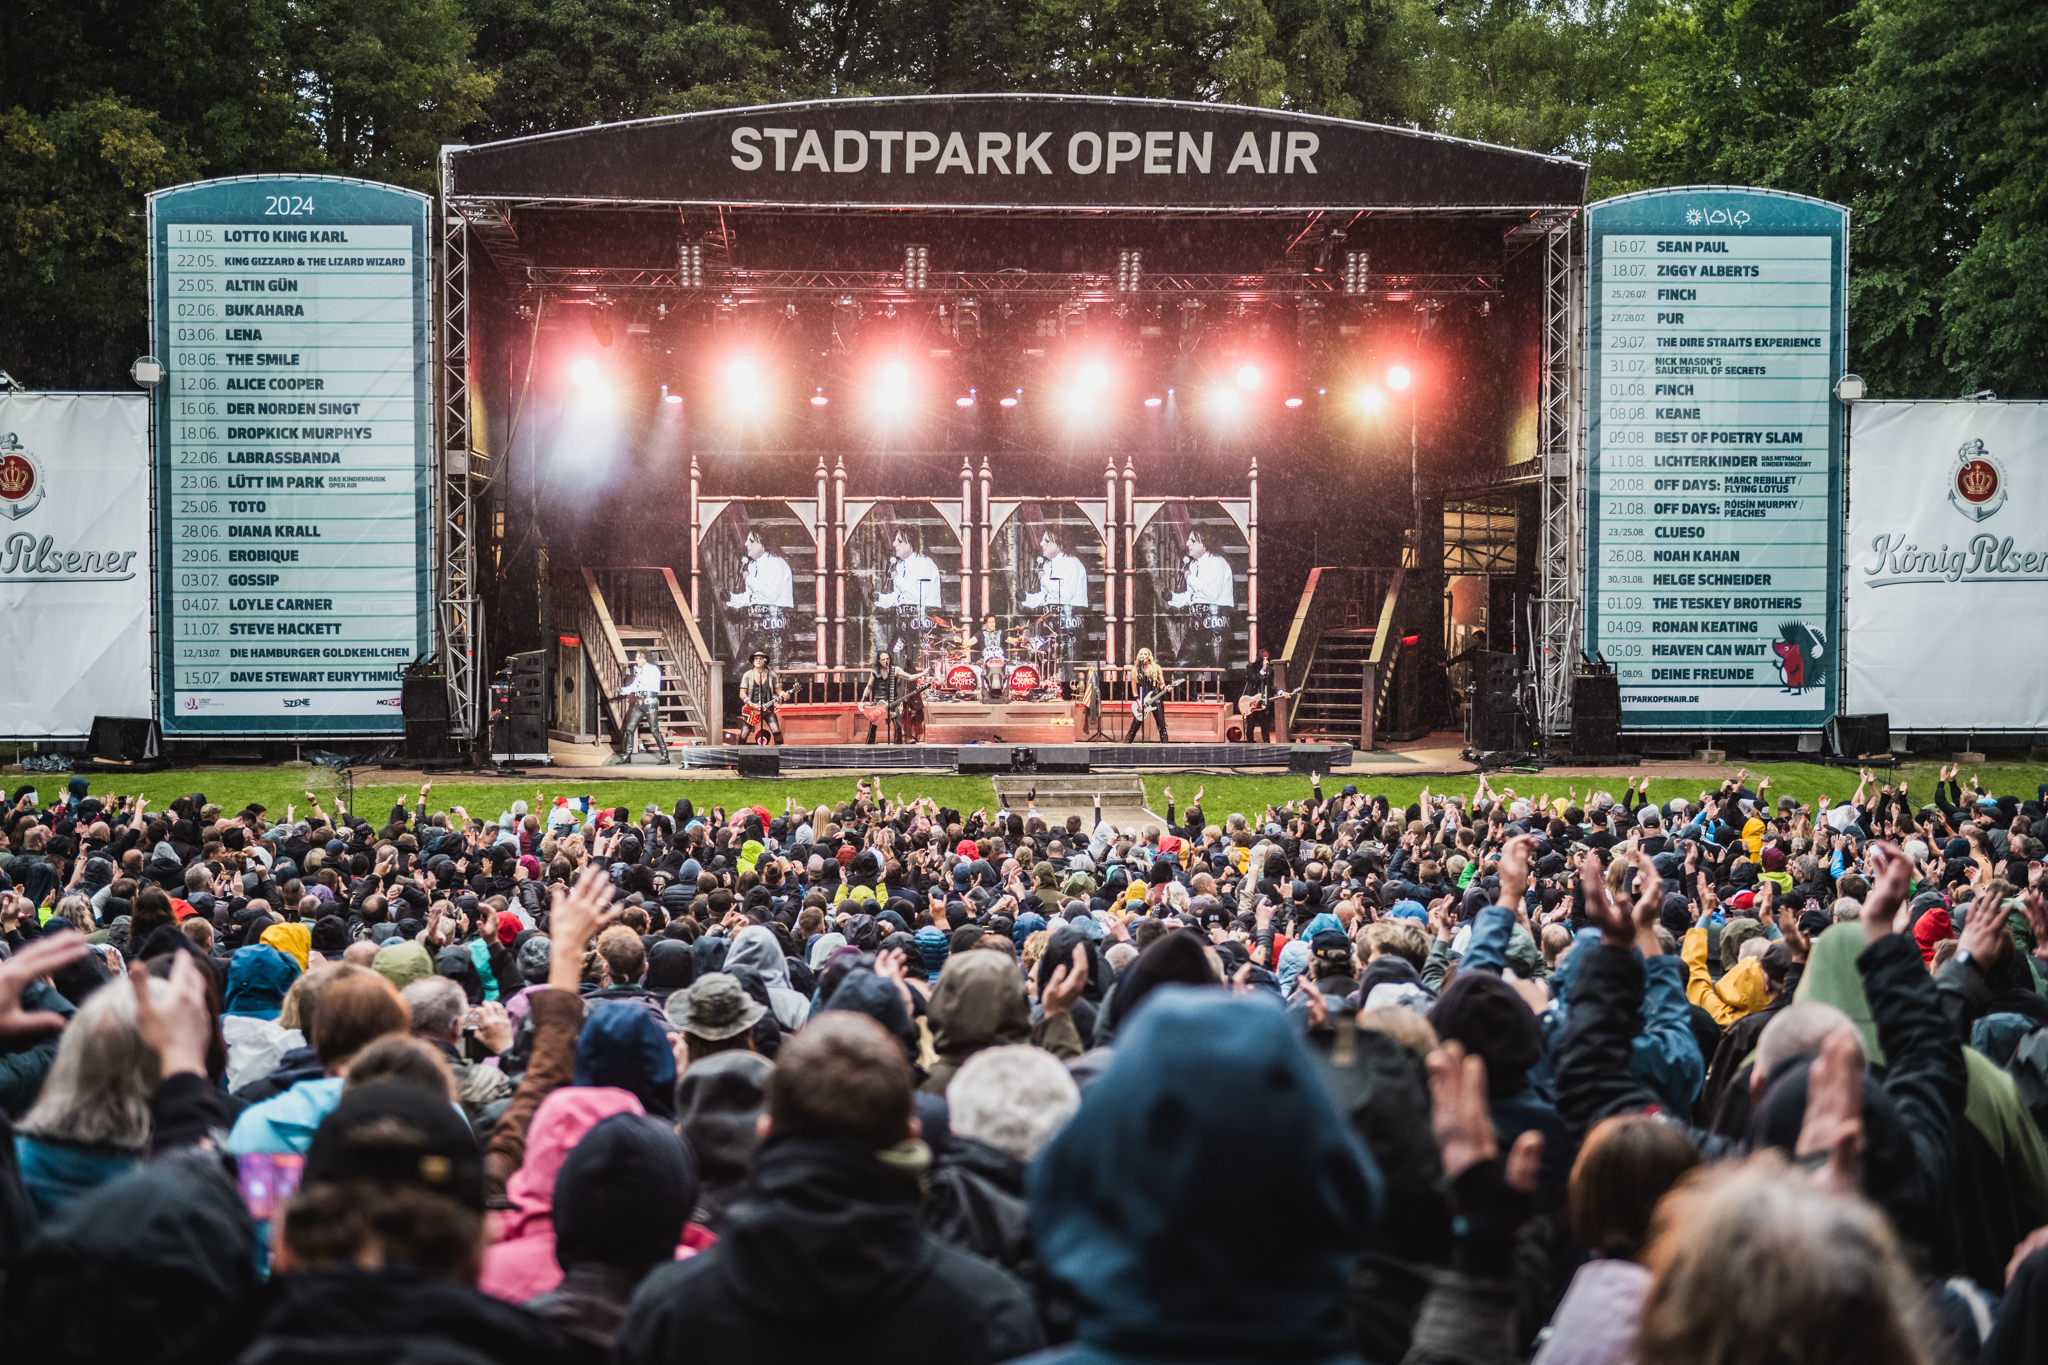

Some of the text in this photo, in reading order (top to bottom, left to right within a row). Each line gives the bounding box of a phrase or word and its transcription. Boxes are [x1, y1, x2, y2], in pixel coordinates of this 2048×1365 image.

[730, 127, 1320, 175] STADTPARK OPEN AIR
[265, 196, 314, 215] 2024
[178, 230, 215, 242] 11.05.
[225, 230, 348, 242] LOTTO KING KARL
[1613, 241, 1646, 252] 16.07.
[1657, 241, 1729, 253] SEAN PAUL
[177, 255, 217, 267] 22.05.
[225, 257, 405, 266] KING GIZZARD & THE LIZARD WIZARD
[1613, 265, 1646, 276] 18.07.
[1657, 265, 1759, 277] ZIGGY ALBERTS
[178, 279, 216, 291] 25.05.
[225, 278, 297, 292] ALTIN GÜN
[1658, 289, 1696, 300] FINCH
[178, 304, 217, 316] 02.06.
[225, 304, 304, 316] BUKAHARA
[1658, 313, 1684, 324] PUR
[179, 328, 217, 340] 03.06.
[226, 329, 262, 341] LENA
[1611, 336, 1645, 348] 29.07.
[1657, 338, 1821, 347] THE DIRE STRAITS EXPERIENCE
[179, 353, 218, 365] 08.06.
[226, 354, 299, 366] THE SMILE
[1655, 357, 1721, 366] NICK MASON'S
[1611, 360, 1645, 372] 31.07.
[1655, 366, 1766, 375] SAUCERFUL OF SECRETS
[180, 378, 219, 390] 12.06.
[227, 378, 324, 390] ALICE COOPER
[1610, 384, 1647, 396] 01.08.
[1655, 384, 1693, 396] FINCH
[181, 402, 218, 414] 16.06.
[227, 403, 360, 415] DER NORDEN SINGT
[1610, 408, 1647, 420] 08.08.
[1656, 408, 1700, 419] KEANE
[181, 427, 219, 439] 18.06.
[228, 427, 372, 439] DROPKICK MURPHYS
[1610, 431, 1646, 443] 09.08.
[1655, 432, 1802, 443] BEST OF POETRY SLAM
[180, 452, 220, 463] 22.06.
[228, 452, 340, 464] LABRASSBANDA
[1611, 455, 1646, 467] 11.08.
[1655, 456, 1758, 467] LICHTERKINDER
[26, 448, 46, 484] LAUDATUR
[1990, 454, 2008, 487] LAUDATUR
[181, 476, 220, 488] 23.06.
[228, 474, 324, 488] LÜTT IM PARK
[1609, 479, 1646, 490] 20.08.
[1655, 479, 1720, 491] OFF DAYS:
[1725, 476, 1796, 485] MARC REBILLET
[1725, 485, 1789, 493] FLYING LOTUS
[181, 501, 220, 513] 25.06.
[229, 501, 266, 513] TOTO
[1609, 503, 1645, 514] 21.08.
[1654, 503, 1720, 514] OFF DAYS:
[1724, 499, 1798, 510] RÓISÍN MURPHY
[1725, 509, 1766, 517] PEACHES
[182, 525, 220, 537] 28.06.
[229, 526, 321, 537] DIANA KRALL
[1655, 527, 1705, 538] CLUESO
[2, 532, 136, 573] Pilsener
[182, 550, 221, 562] 29.06.
[229, 550, 298, 563] EROBIQUE
[1609, 550, 1645, 562] 26.08.
[1654, 551, 1739, 562] NOAH KAHAN
[182, 574, 218, 586] 03.07.
[228, 574, 279, 586] GOSSIP
[1653, 574, 1771, 585] HELGE SCHNEIDER
[182, 599, 219, 611] 04.07.
[230, 599, 332, 610] LOYLE CARNER
[1608, 597, 1643, 609] 01.09.
[1653, 598, 1802, 609] THE TESKEY BROTHERS
[184, 623, 219, 635] 11.07.
[230, 623, 342, 635] STEVE HACKETT
[1608, 621, 1643, 633] 04.09.
[1653, 621, 1758, 633] RONAN KEATING
[230, 648, 409, 658] DIE HAMBURGER GOLDKEHLCHEN
[1607, 645, 1643, 656] 05.09.
[1652, 645, 1767, 655] HEAVEN CAN WAIT
[185, 672, 220, 684] 15.07.
[231, 672, 263, 682] DAVE
[266, 672, 325, 682] STEWART
[1652, 669, 1754, 679] DEINE FREUNDE
[1620, 695, 1700, 703] DTPARKOPENAIR.DE
